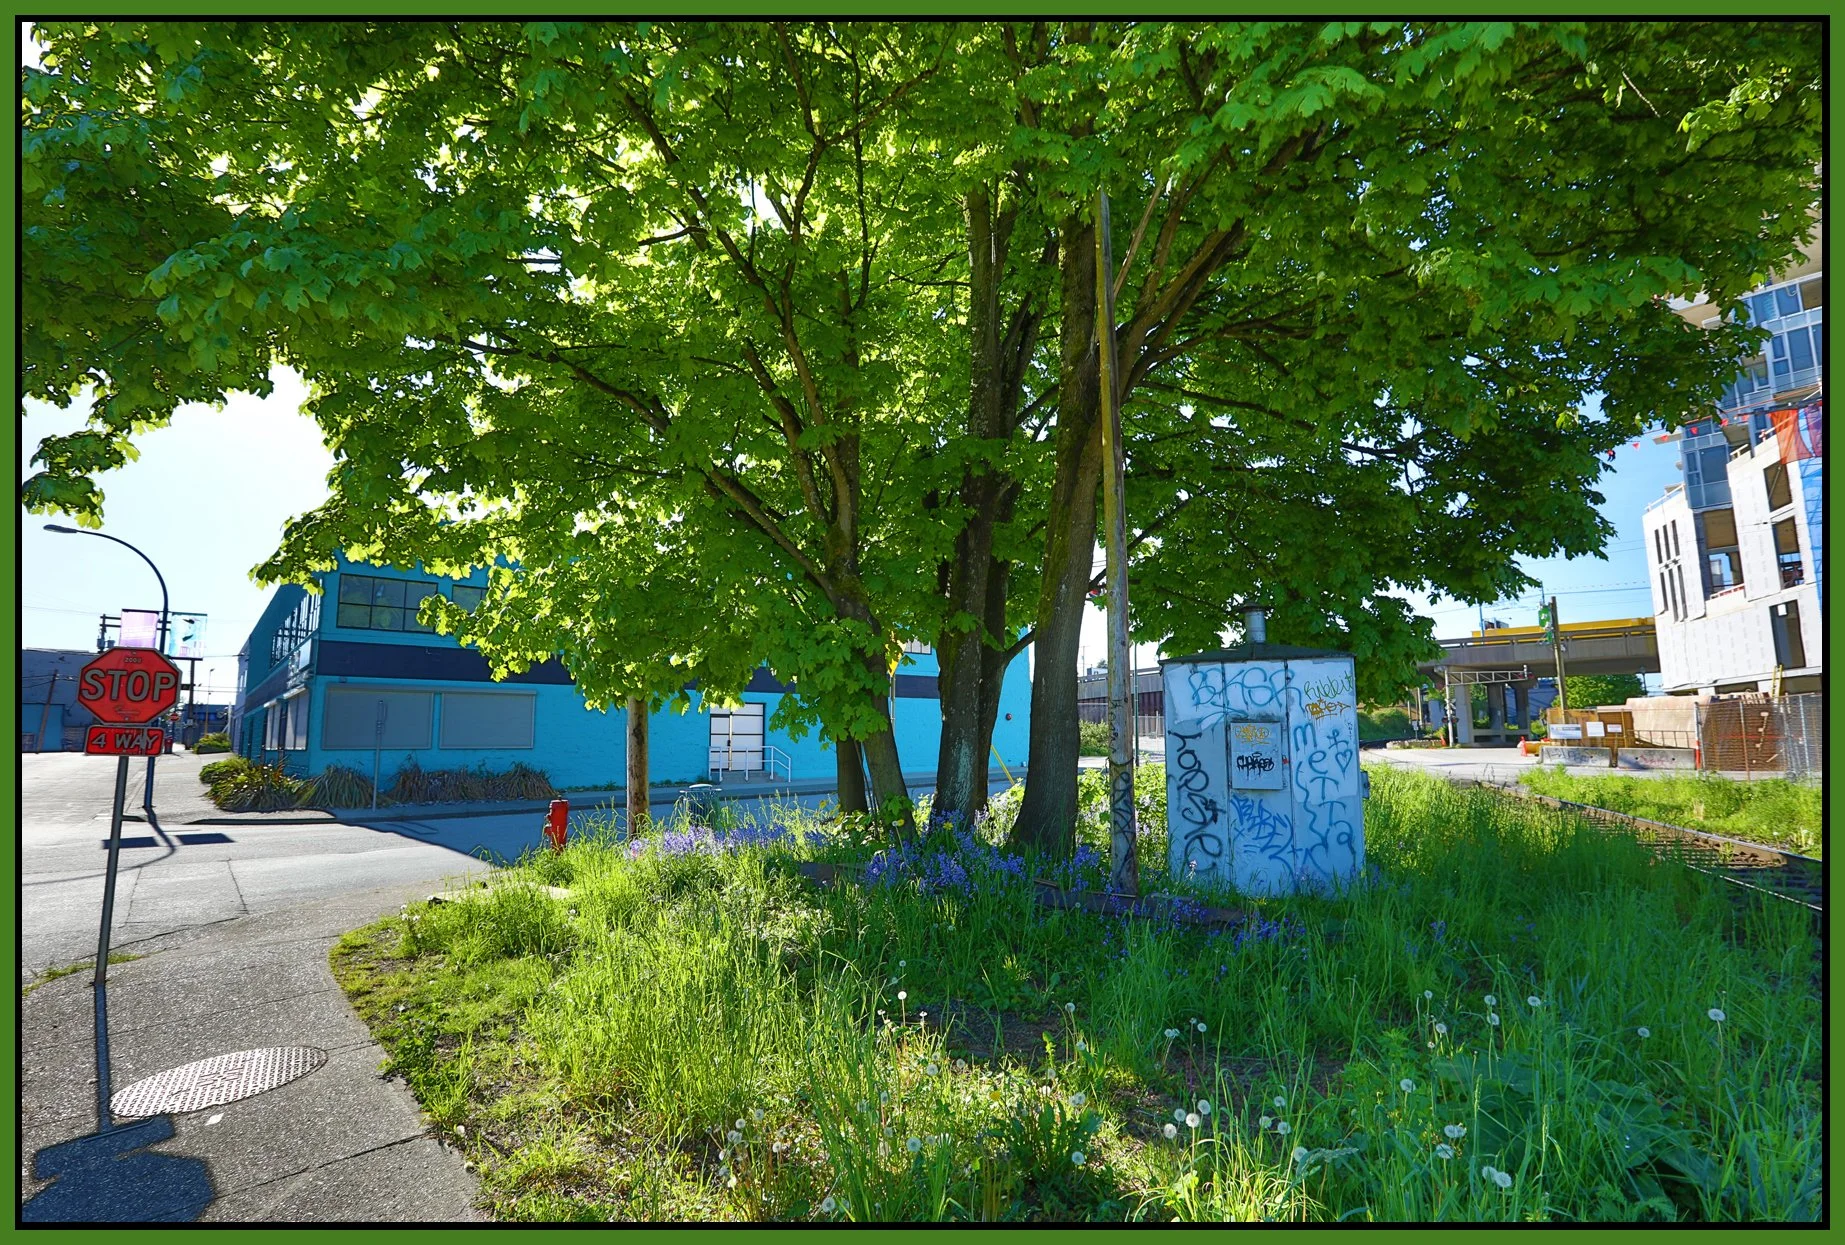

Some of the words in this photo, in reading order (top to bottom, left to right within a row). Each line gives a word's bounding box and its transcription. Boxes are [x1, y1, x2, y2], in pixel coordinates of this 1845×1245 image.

[81, 668, 176, 702] STOP
[92, 733, 106, 748] 4
[115, 734, 159, 750] WAY
